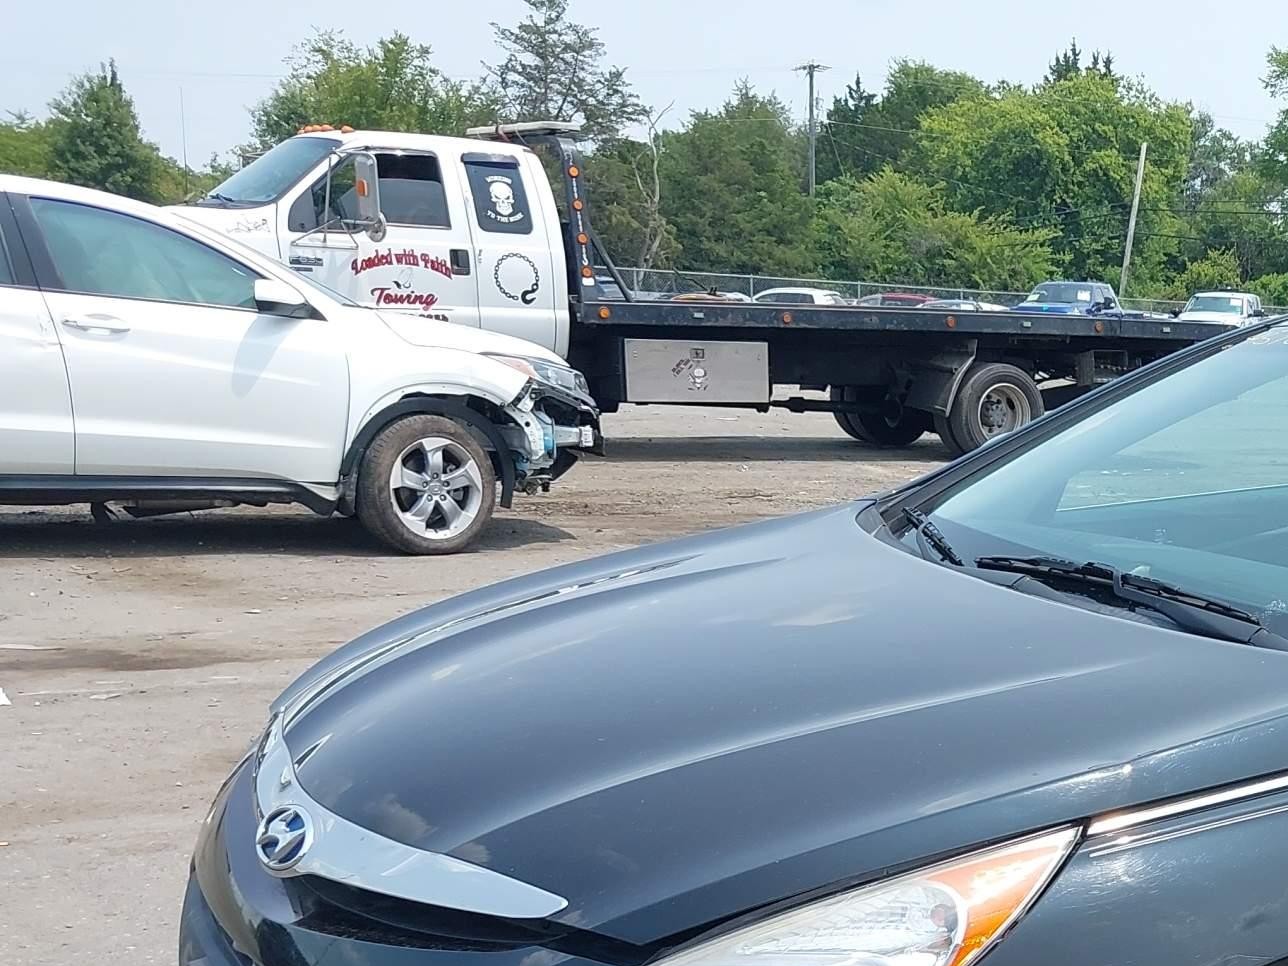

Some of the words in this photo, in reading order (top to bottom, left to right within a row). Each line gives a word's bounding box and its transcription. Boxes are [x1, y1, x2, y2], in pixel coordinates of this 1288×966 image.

[351, 248, 394, 275] Loaded
[394, 248, 420, 267] with
[370, 287, 438, 311] Towing
